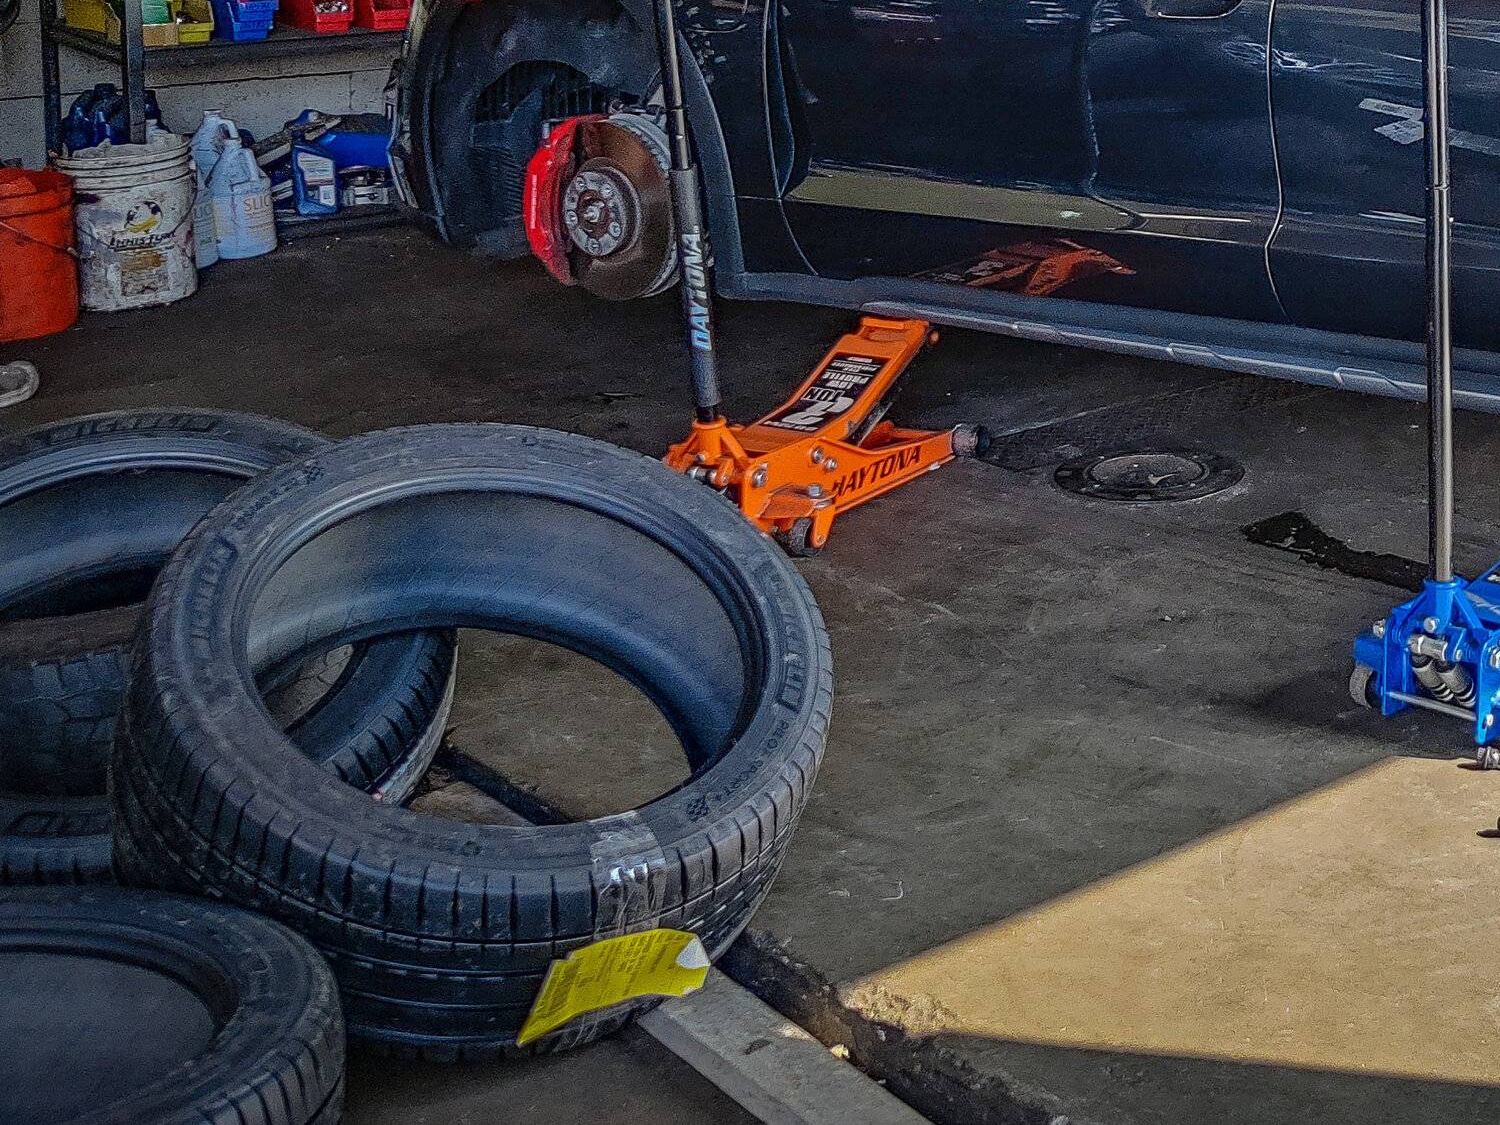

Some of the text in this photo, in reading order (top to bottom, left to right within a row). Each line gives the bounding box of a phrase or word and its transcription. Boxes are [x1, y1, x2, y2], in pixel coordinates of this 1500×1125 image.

[681, 233, 713, 352] DAYTONA
[800, 386, 846, 403] TON
[825, 380, 854, 390] LOW
[831, 445, 922, 499] DAYTONA
